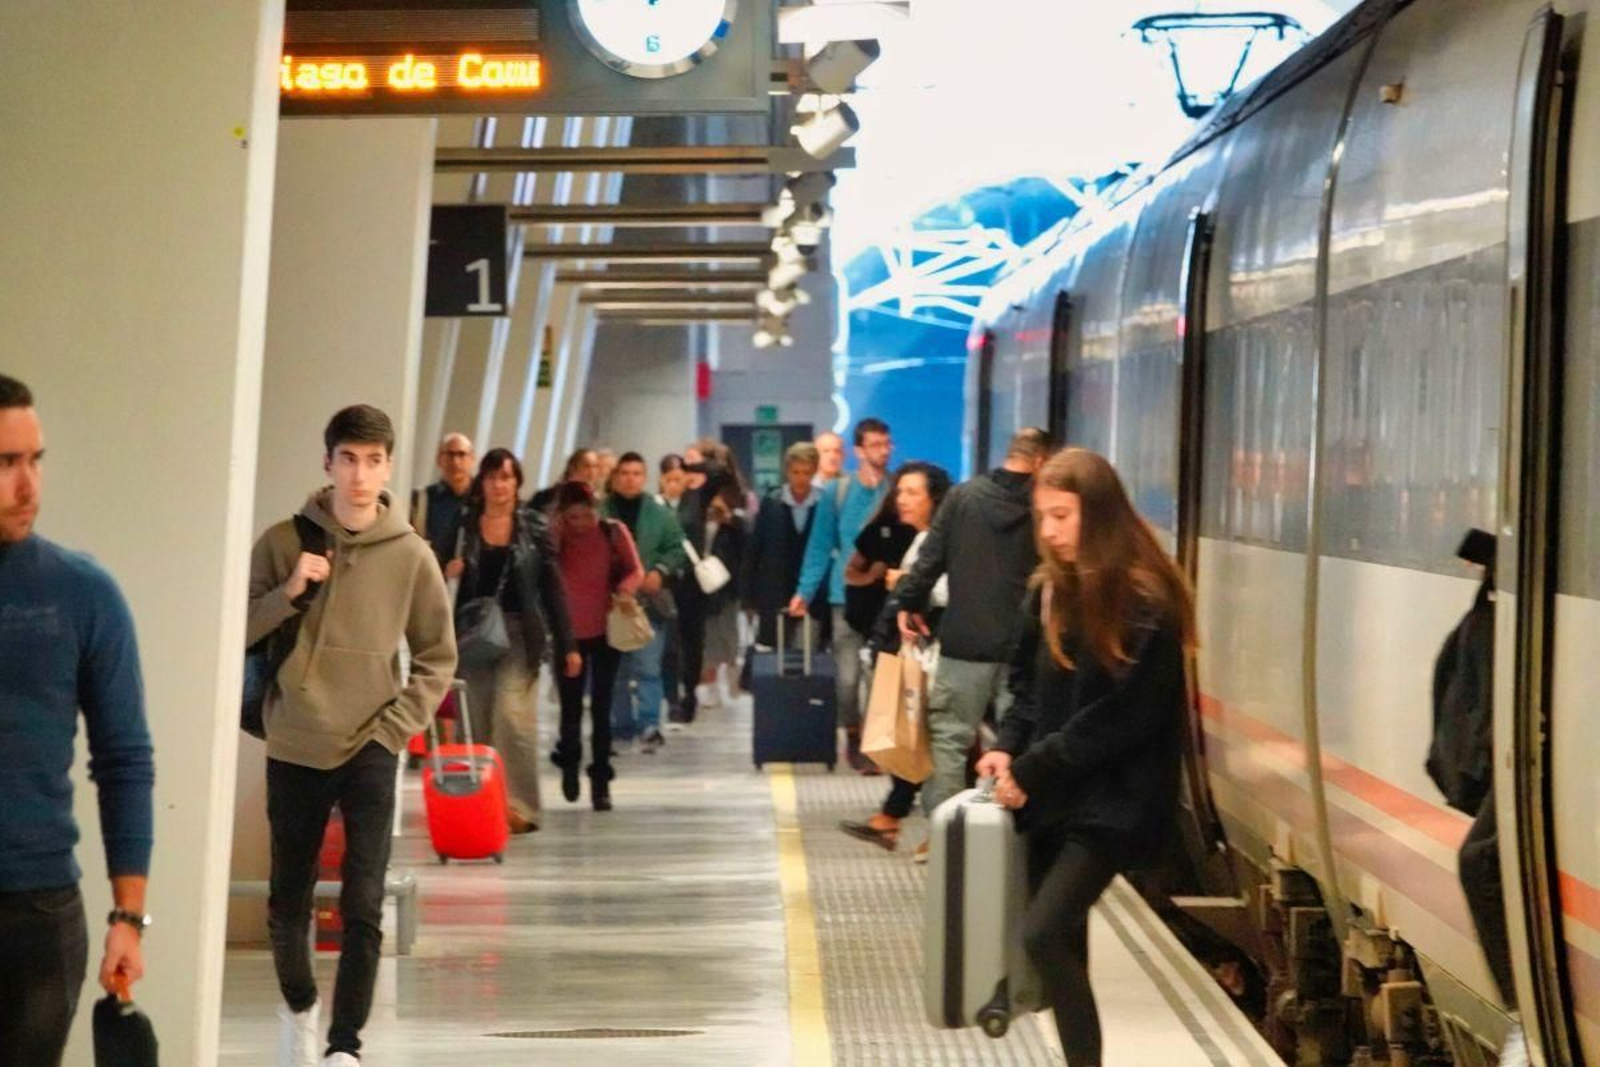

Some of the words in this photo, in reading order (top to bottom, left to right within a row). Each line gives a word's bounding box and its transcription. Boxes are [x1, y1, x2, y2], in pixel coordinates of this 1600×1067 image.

[645, 35, 661, 53] 6
[386, 53, 438, 90] de
[465, 258, 502, 312] 1
